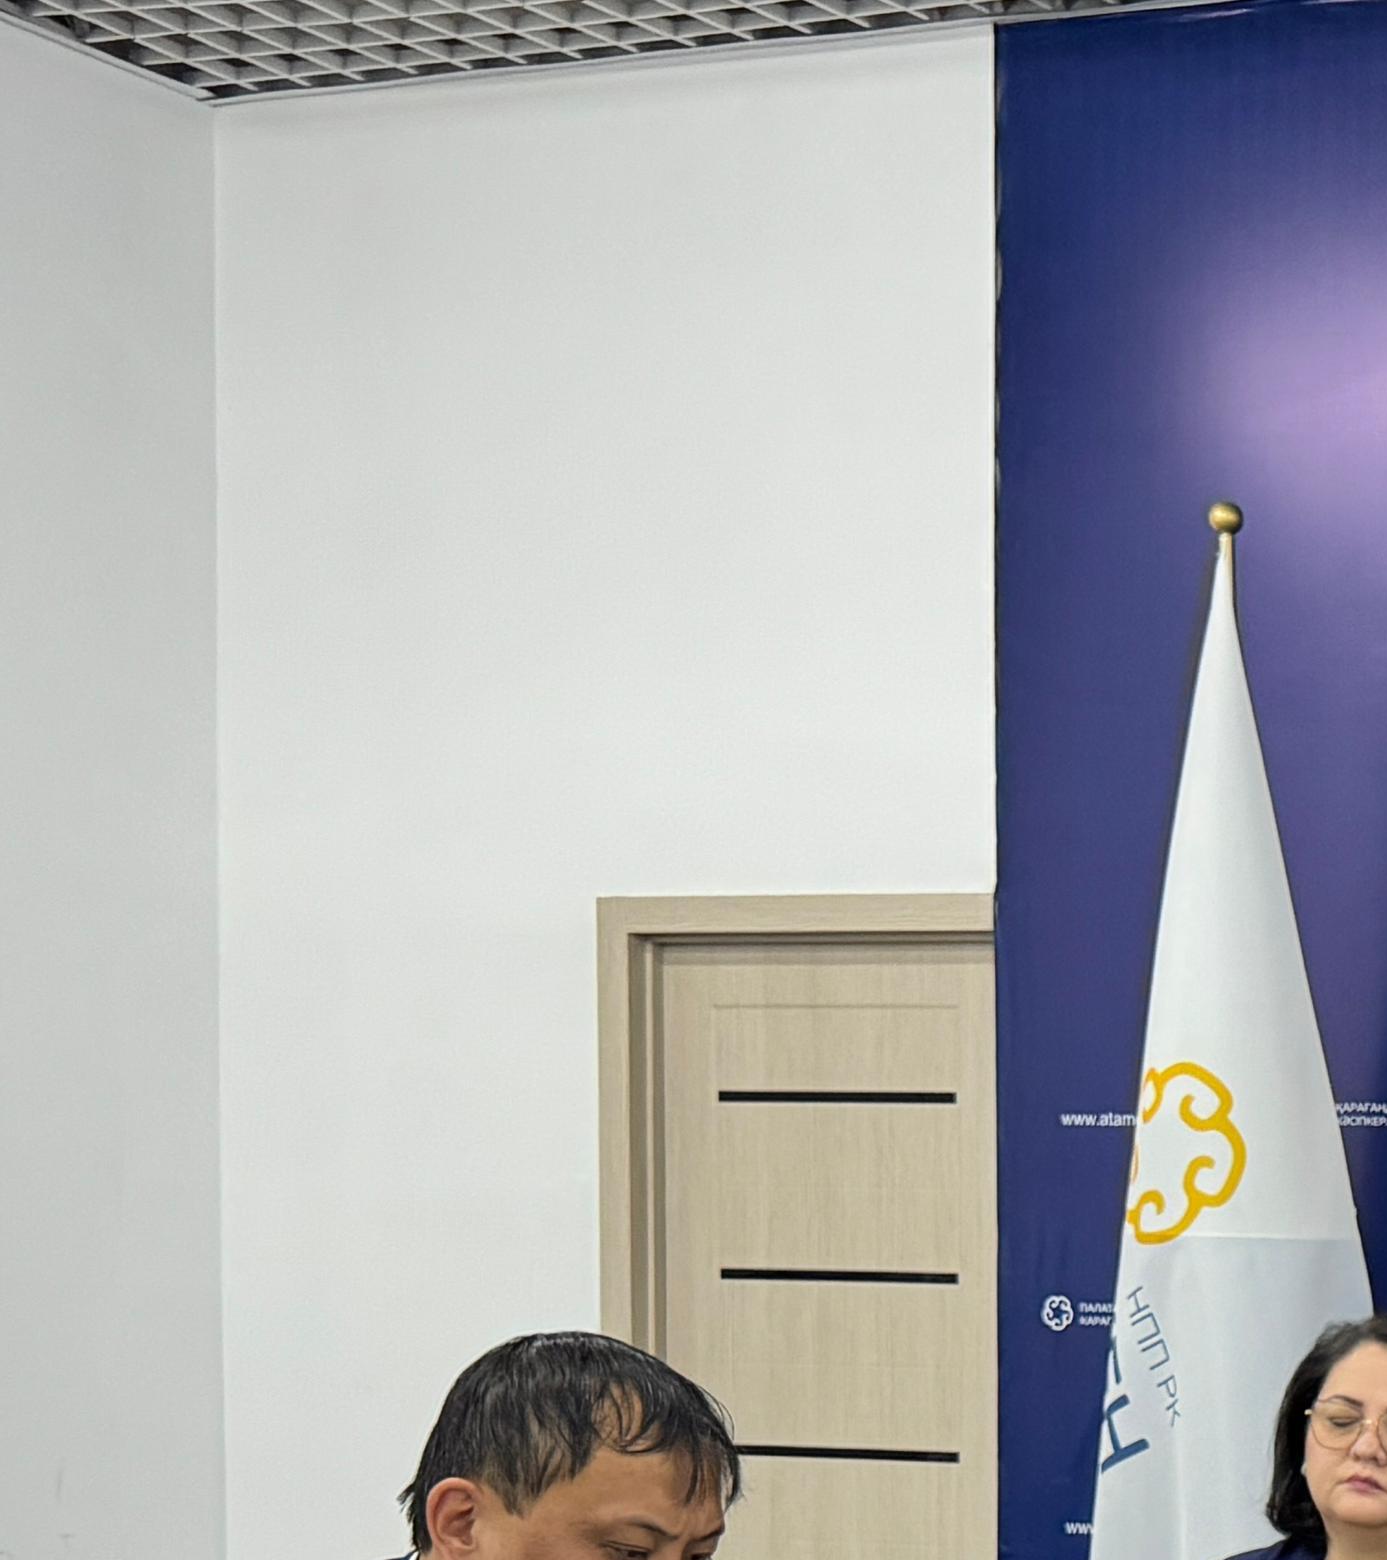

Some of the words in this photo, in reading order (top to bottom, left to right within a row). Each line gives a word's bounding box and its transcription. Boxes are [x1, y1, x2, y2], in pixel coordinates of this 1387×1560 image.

[1062, 1114, 1137, 1127] www.atam
[1127, 1286, 1170, 1371] НПП
[1157, 1375, 1181, 1428] РК
